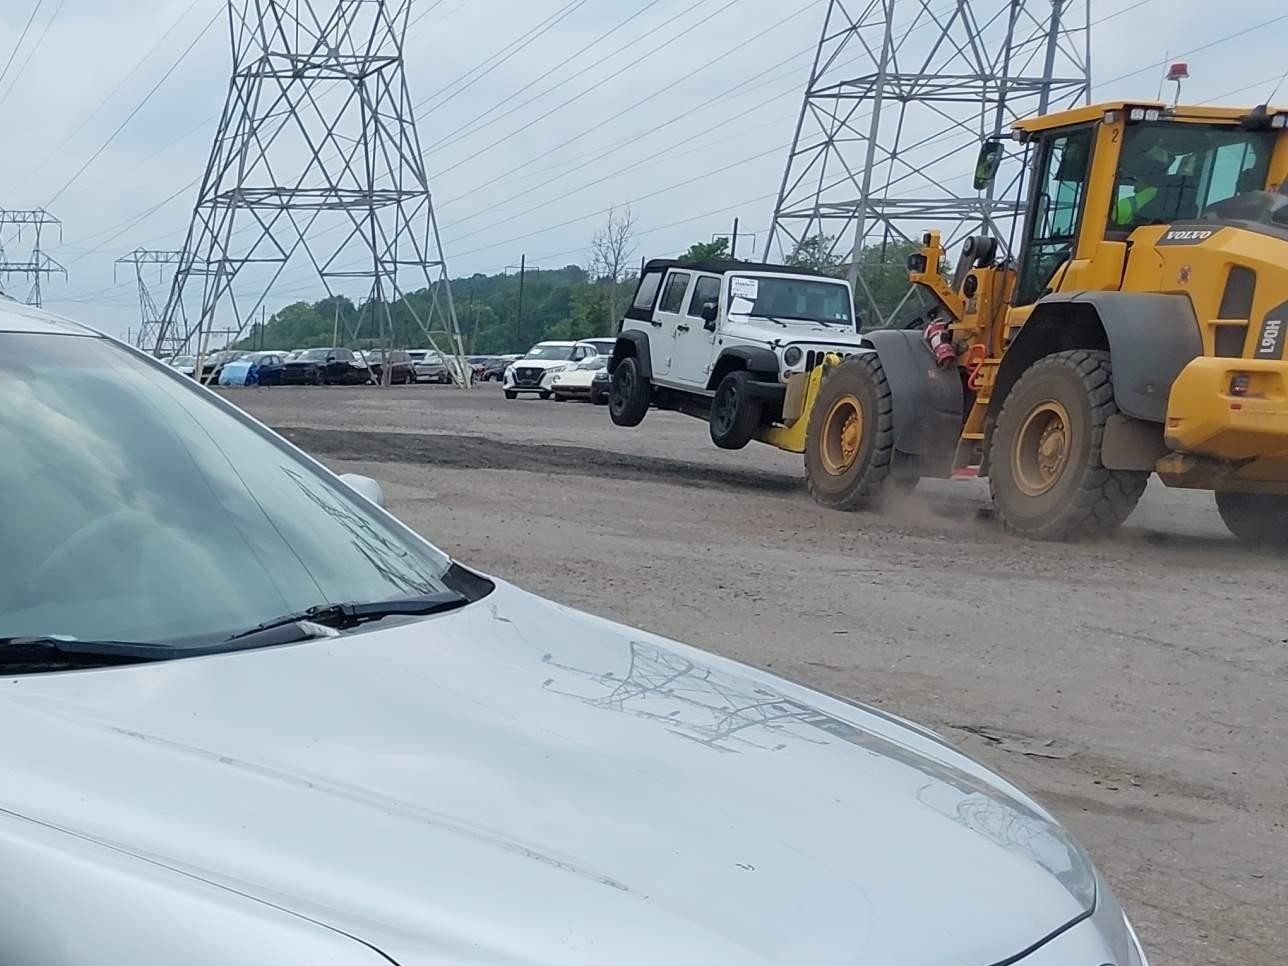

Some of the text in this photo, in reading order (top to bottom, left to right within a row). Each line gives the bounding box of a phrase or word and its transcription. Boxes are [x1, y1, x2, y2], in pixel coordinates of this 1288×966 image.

[1112, 128, 1119, 143] 2
[1167, 231, 1212, 240] VOLVO
[1260, 320, 1281, 352] L90H
